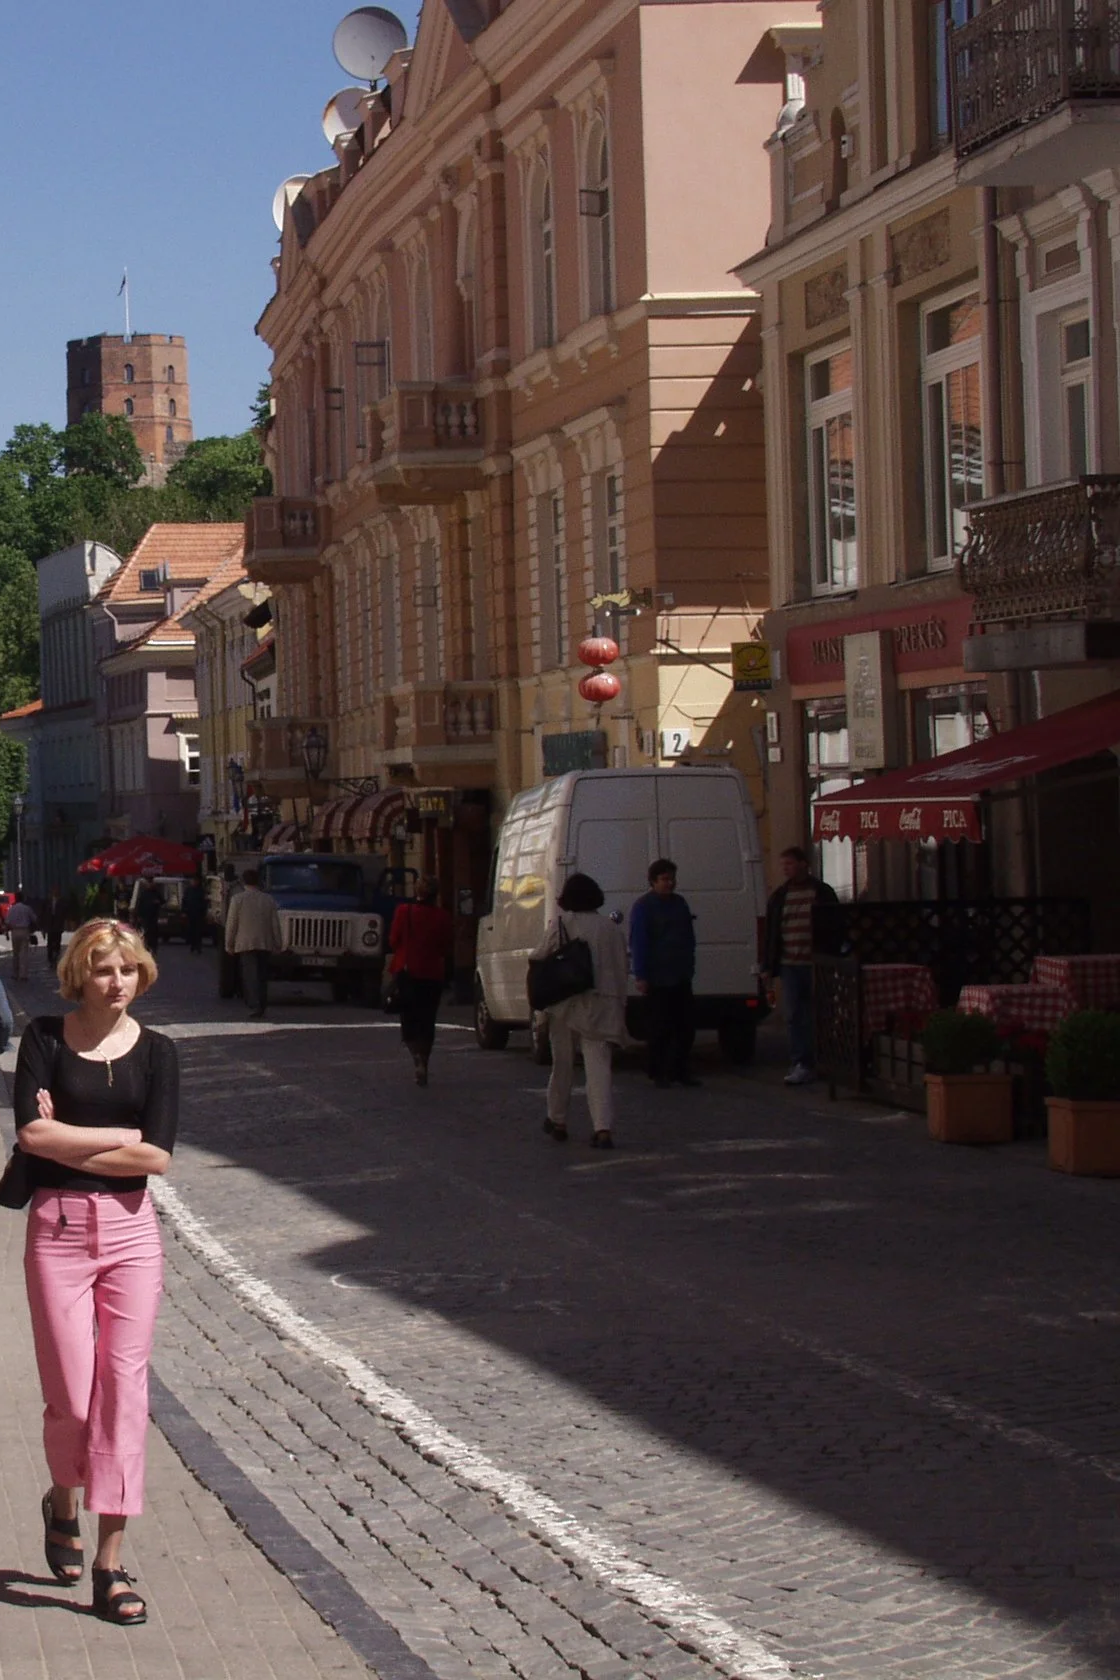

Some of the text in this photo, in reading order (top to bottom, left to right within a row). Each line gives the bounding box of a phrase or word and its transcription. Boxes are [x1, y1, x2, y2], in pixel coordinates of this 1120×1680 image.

[812, 636, 844, 664] MAIST
[673, 732, 683, 753] 2
[860, 811, 880, 829] PICA
[942, 809, 968, 828] PICA
